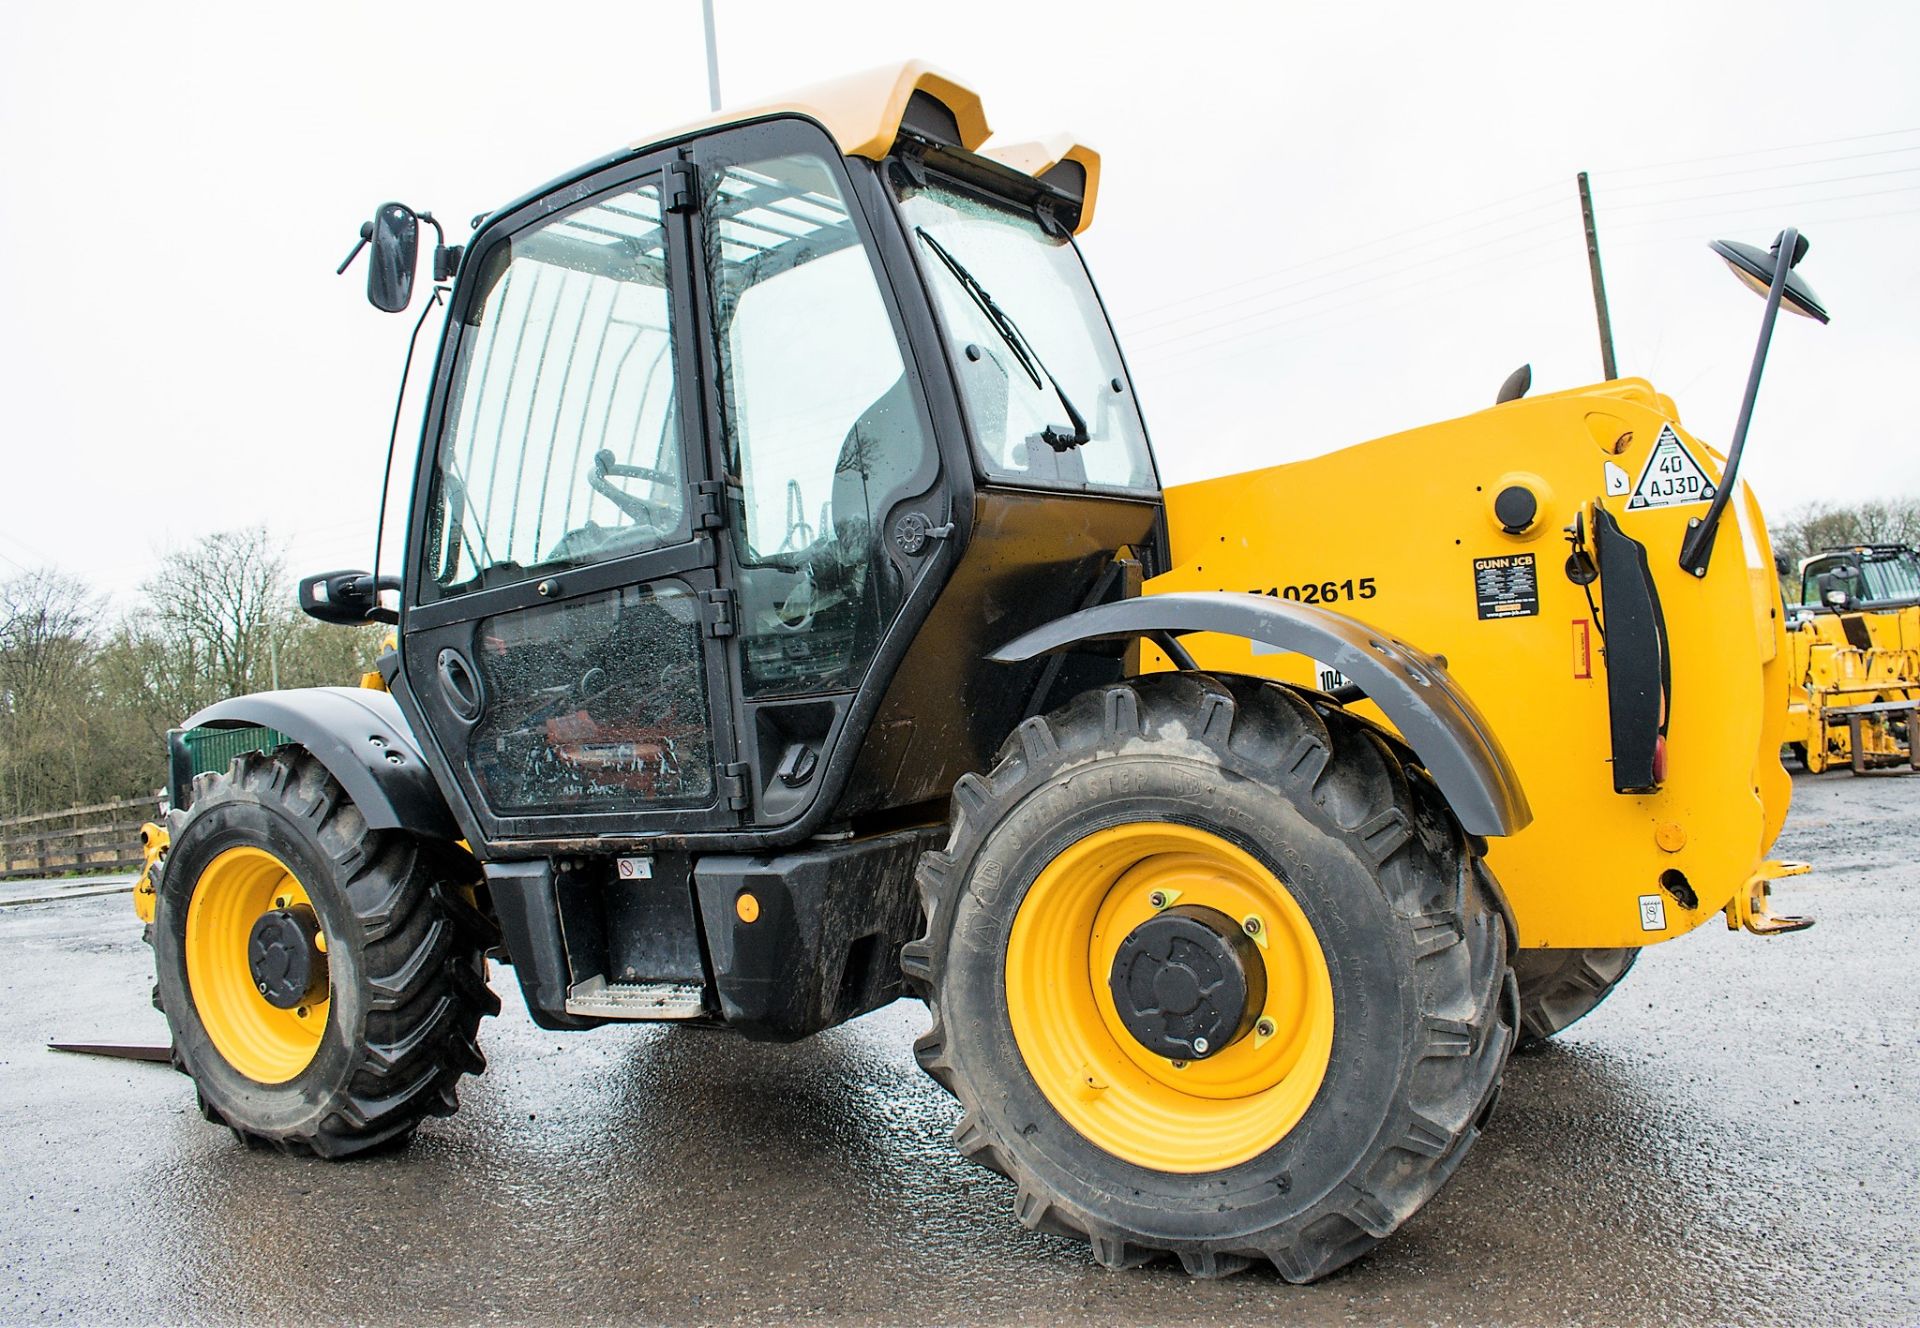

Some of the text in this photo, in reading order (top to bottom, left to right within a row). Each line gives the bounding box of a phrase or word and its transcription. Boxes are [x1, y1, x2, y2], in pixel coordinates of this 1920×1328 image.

[1650, 476, 1699, 497] AJ3D
[1475, 556, 1533, 570] GUNN JCB
[1248, 577, 1377, 604] 02615
[1320, 669, 1342, 691] 104
